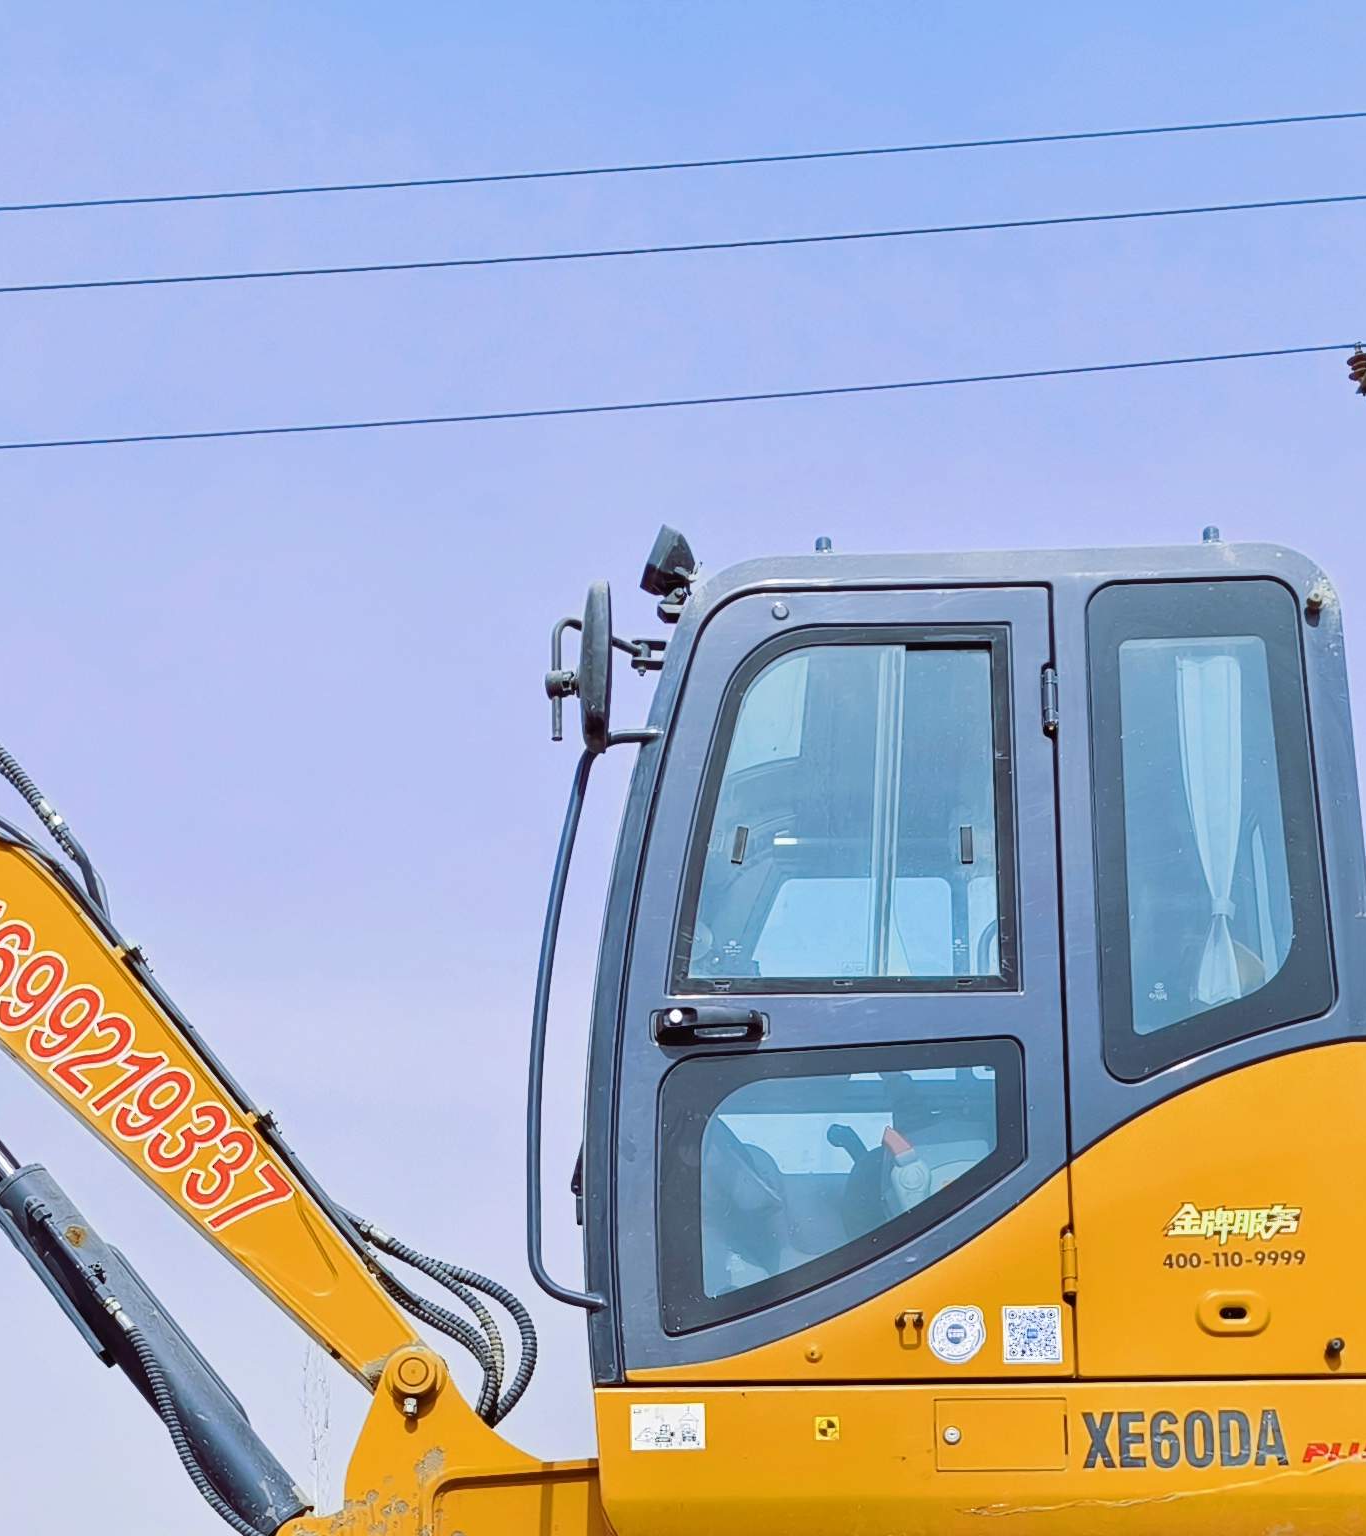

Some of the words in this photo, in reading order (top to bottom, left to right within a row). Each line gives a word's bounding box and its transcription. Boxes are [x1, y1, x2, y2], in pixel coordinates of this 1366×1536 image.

[1162, 1202, 1303, 1246] 金牌服务
[1163, 1250, 1305, 1269] 400-110-9999
[1082, 1409, 1289, 1469] XE60DA
